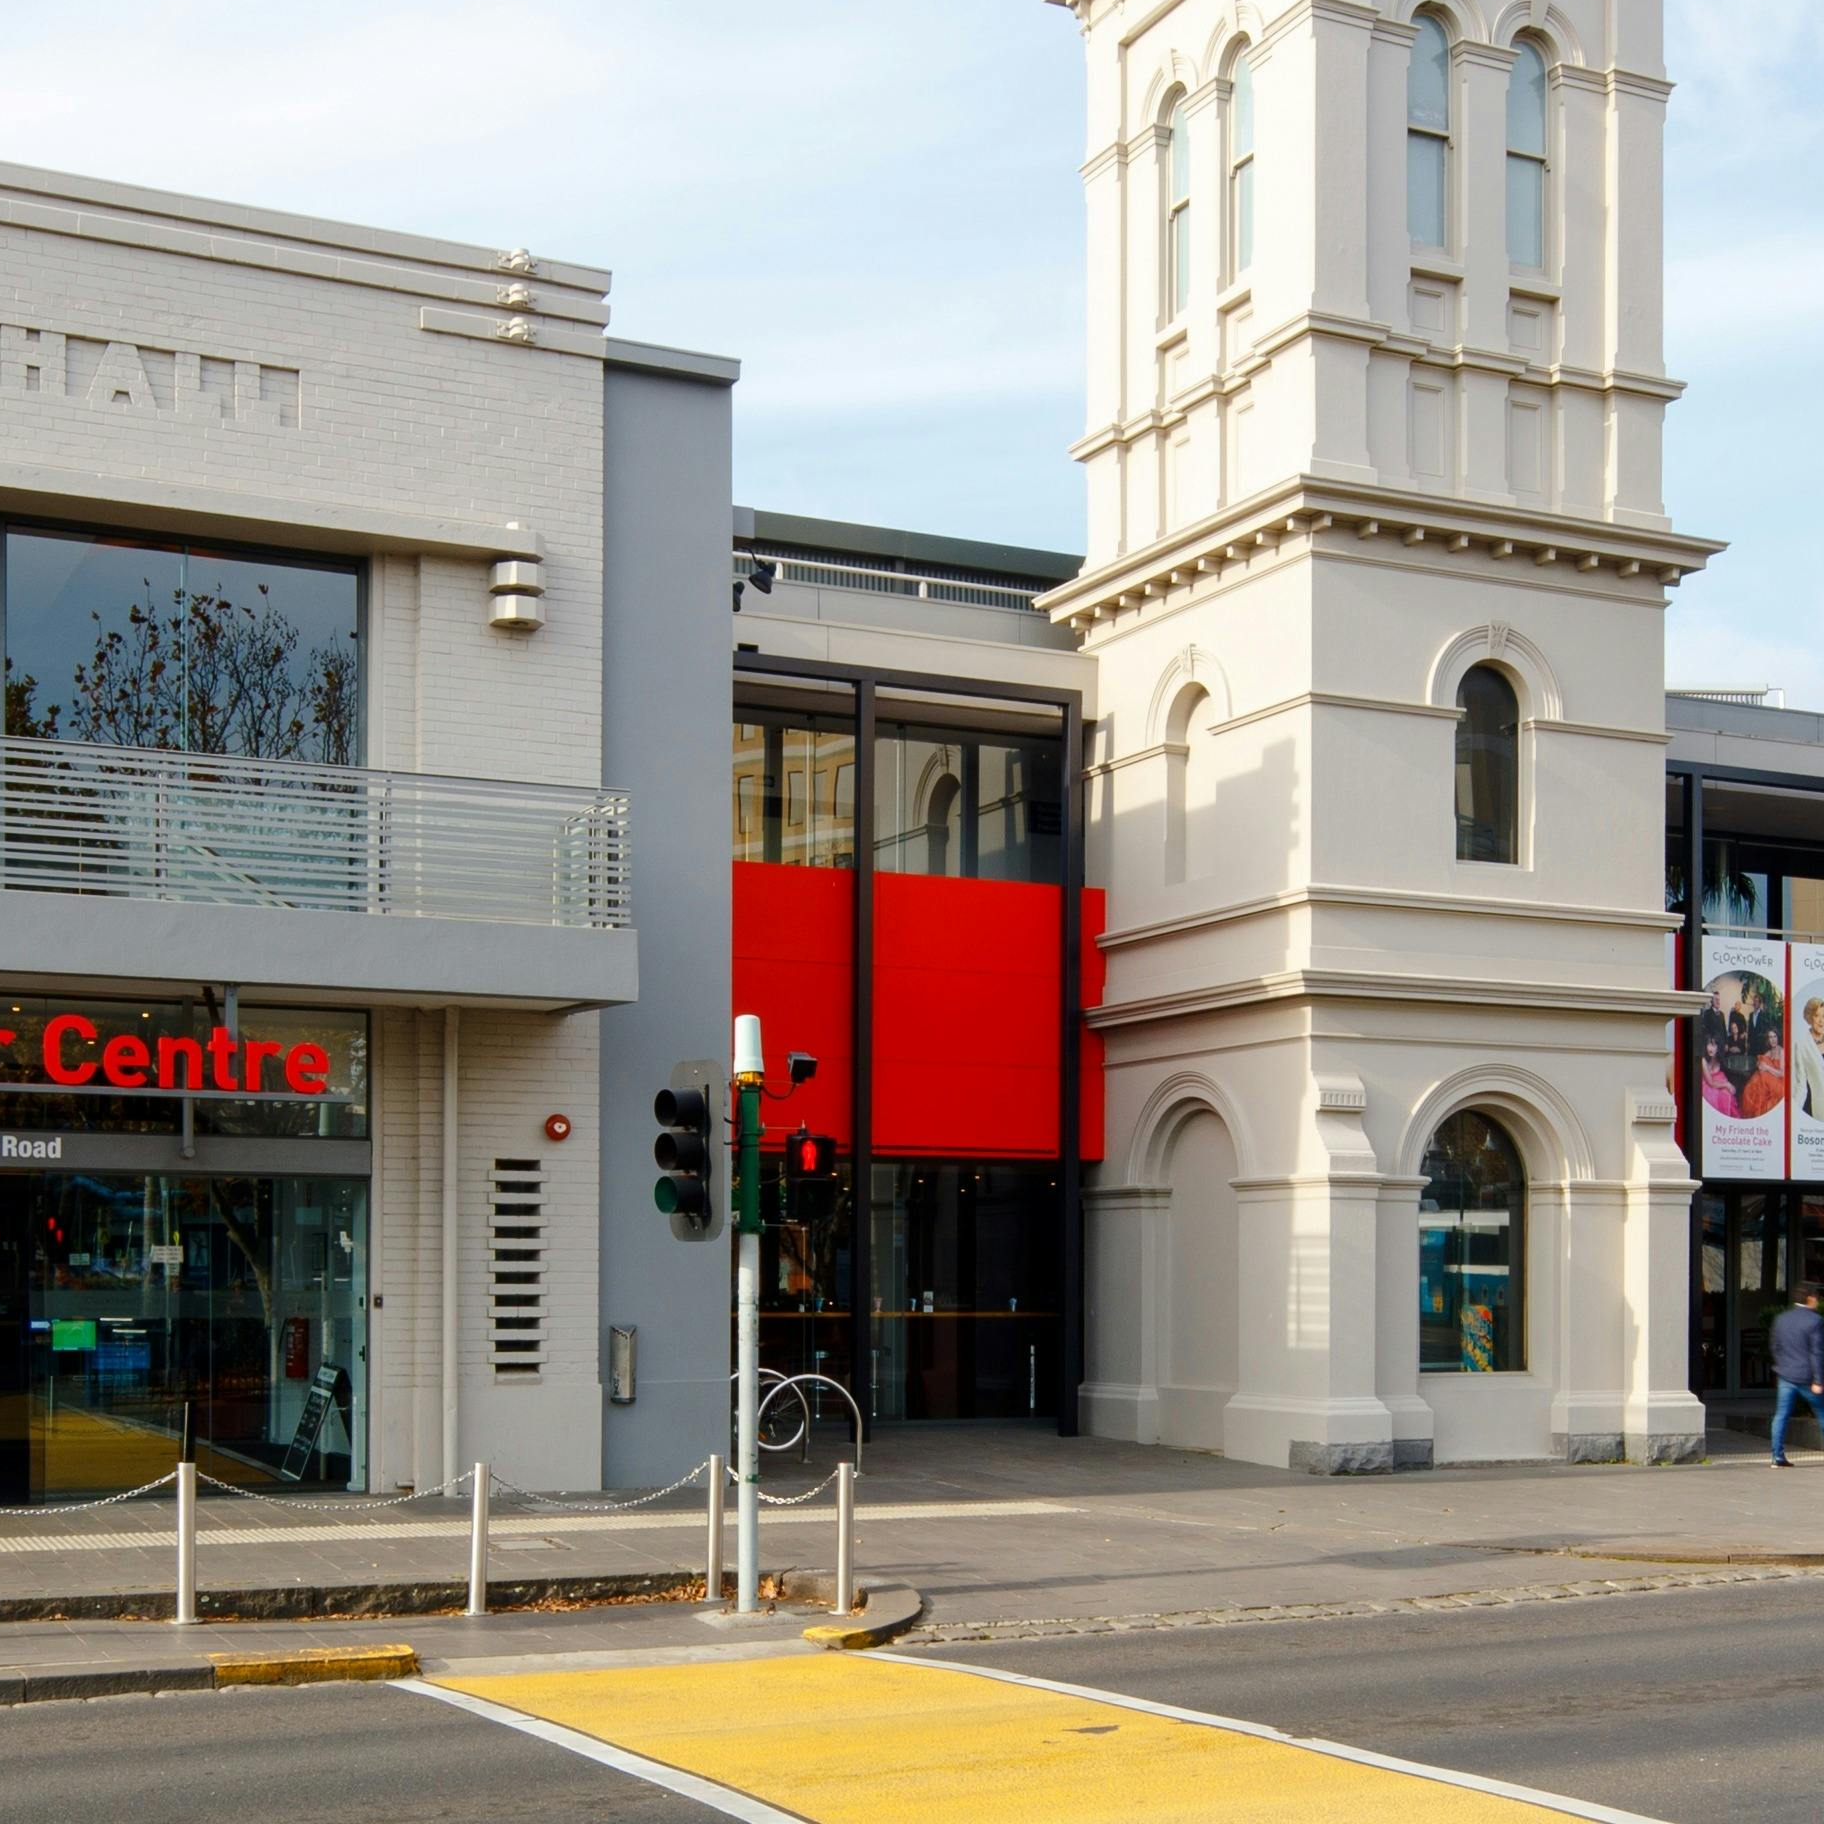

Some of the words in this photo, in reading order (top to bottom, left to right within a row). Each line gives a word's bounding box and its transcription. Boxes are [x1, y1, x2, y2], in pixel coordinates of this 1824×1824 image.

[0, 322, 281, 426] HALL
[1712, 951, 1774, 967] CLOCKTOWER
[42, 1012, 331, 1095] Centre
[1711, 1135, 1751, 1146] Chocolate
[1752, 1137, 1773, 1147] Cake
[1715, 1125, 1728, 1138] My
[1729, 1126, 1755, 1136] Friend
[1755, 1127, 1770, 1137] the
[1, 1135, 63, 1159] Road
